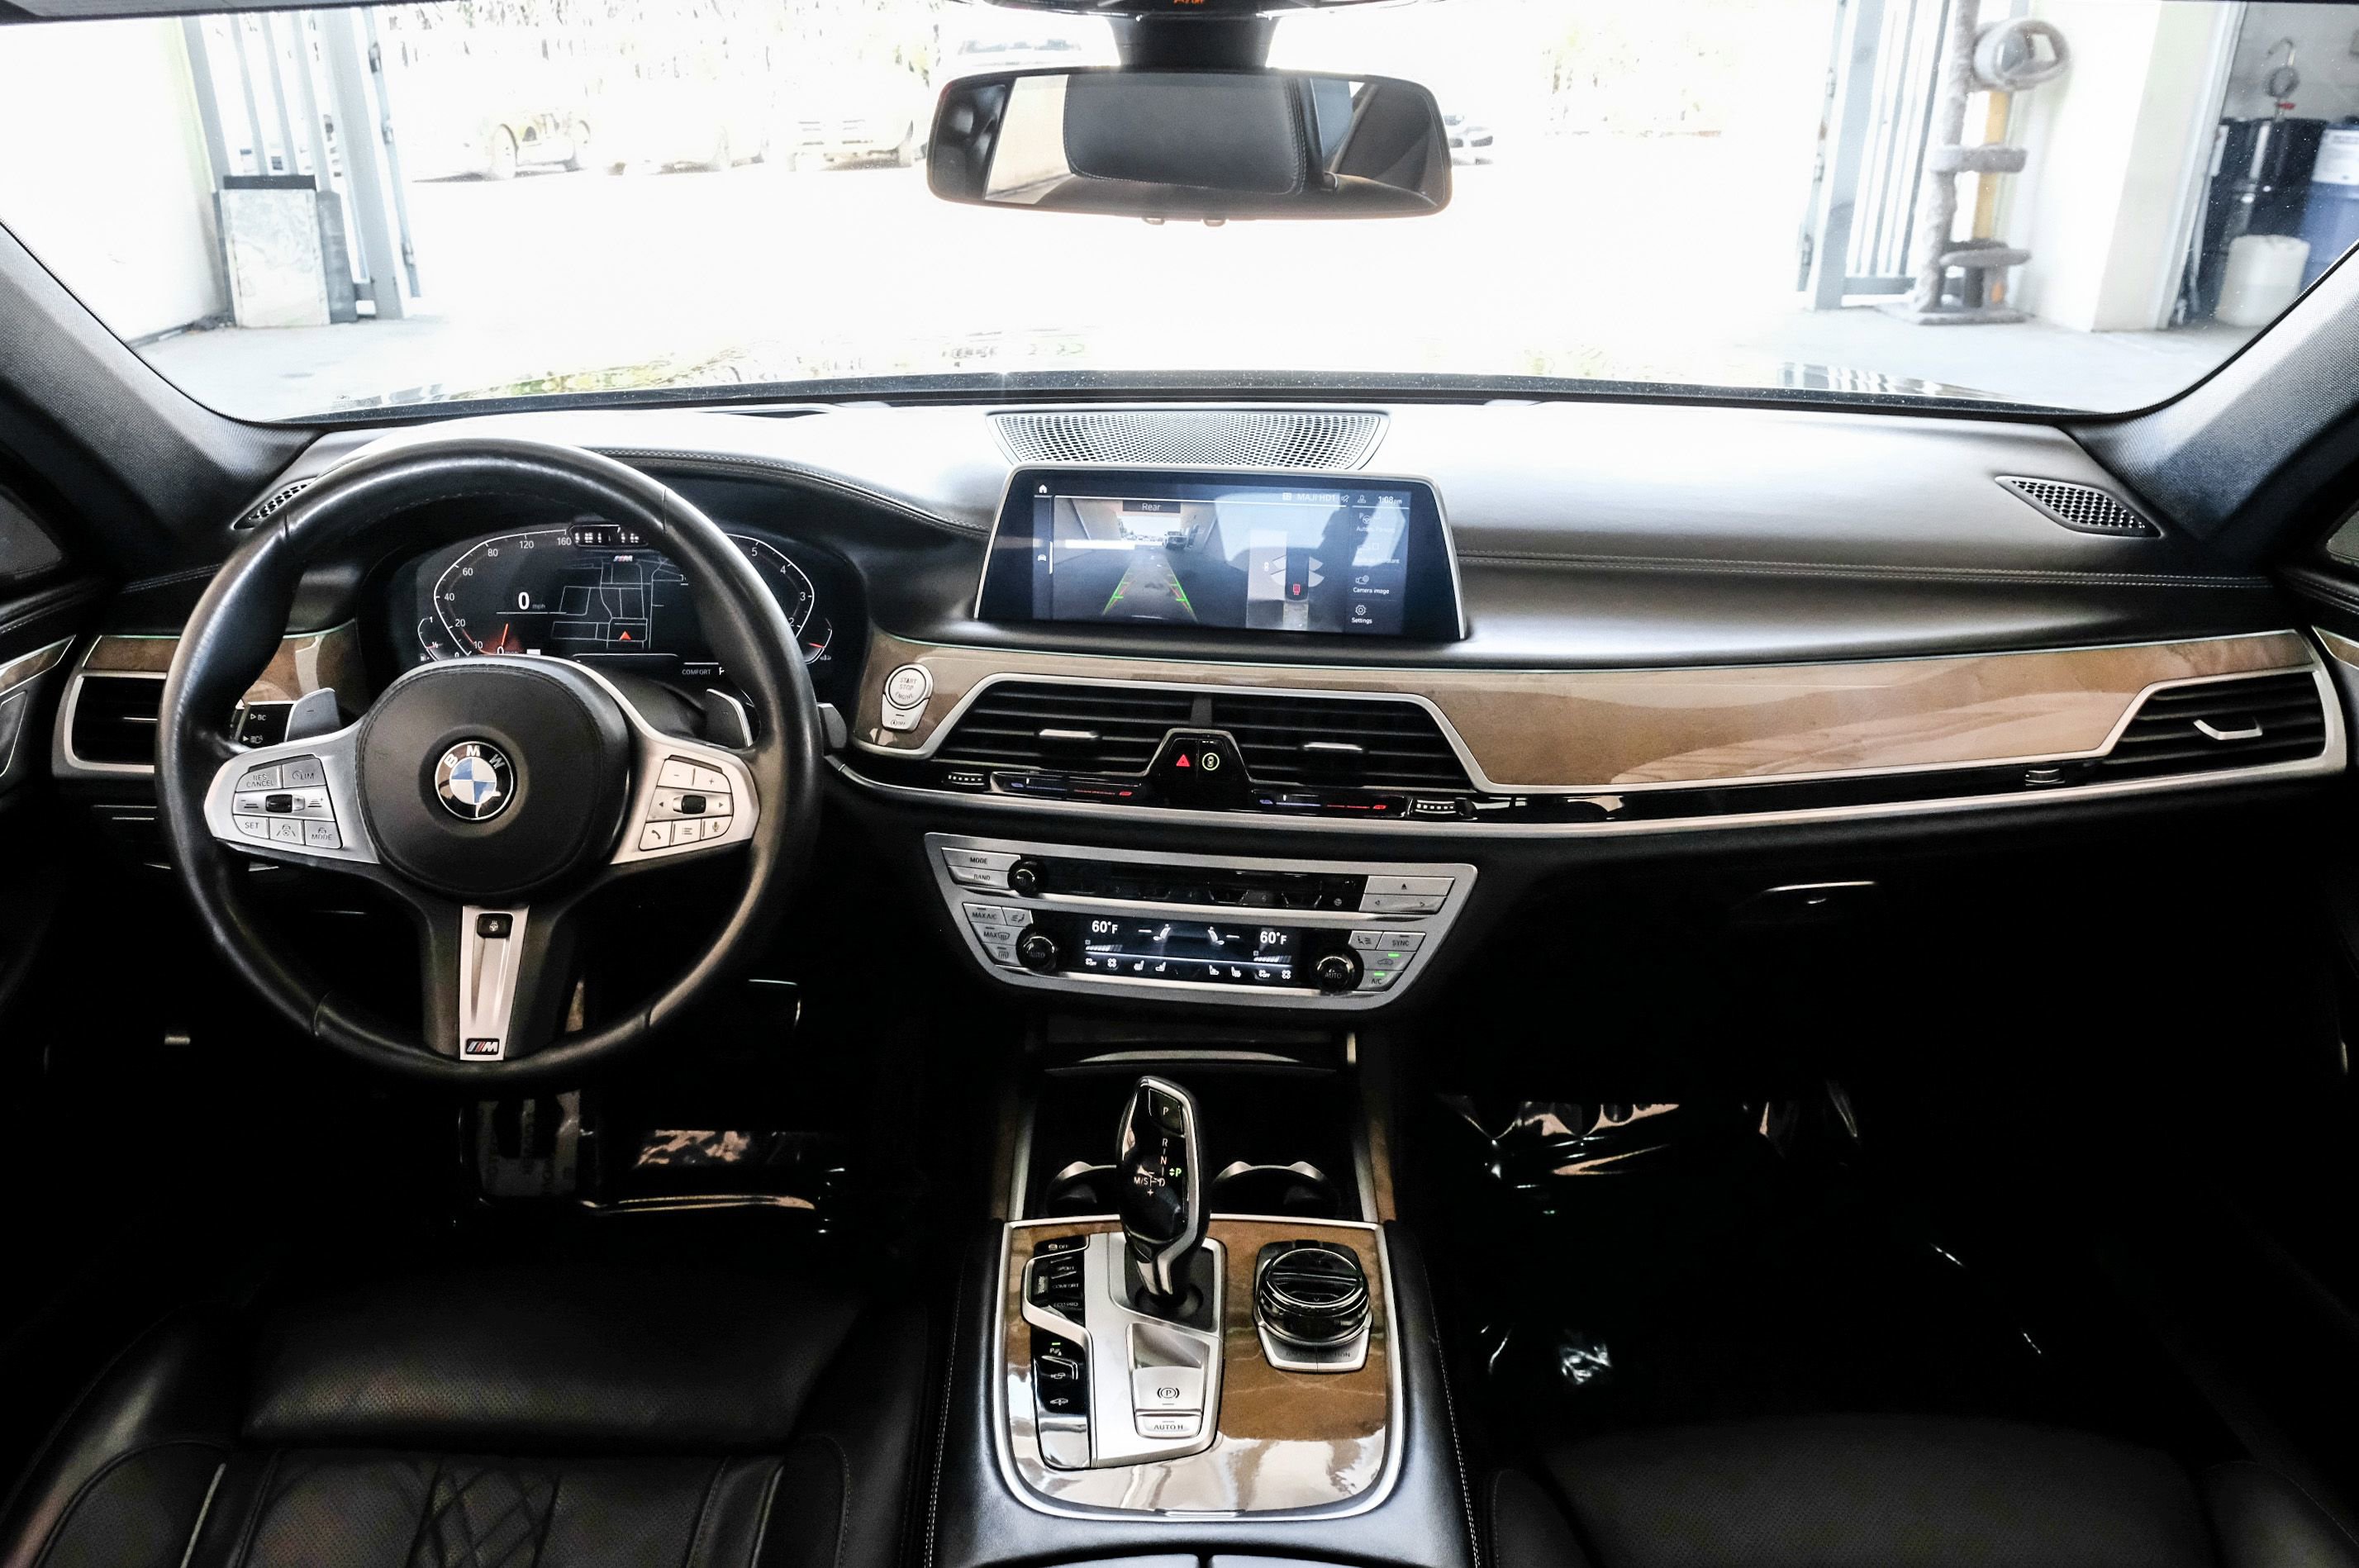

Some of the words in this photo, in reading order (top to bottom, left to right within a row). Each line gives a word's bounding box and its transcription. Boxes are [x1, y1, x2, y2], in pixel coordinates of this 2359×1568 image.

[1142, 502, 1162, 511] Rear
[519, 540, 535, 549] 120
[557, 537, 572, 546] 160
[487, 549, 498, 557] 80
[751, 547, 758, 557] 5
[462, 568, 473, 577] 60
[779, 565, 787, 574] 4
[444, 593, 455, 601] 40
[518, 592, 530, 610] 0
[799, 592, 806, 601] 3
[454, 619, 466, 627] 20
[788, 617, 795, 627] 2
[473, 640, 483, 649] 10
[444, 745, 506, 769] BMW
[246, 780, 274, 788] CANCEL
[1092, 919, 1119, 934] 60°F
[983, 930, 997, 938] MAX
[1259, 930, 1287, 945] 60°F
[1163, 1106, 1169, 1116] P
[1162, 1138, 1168, 1147] R
[1160, 1156, 1168, 1166] N
[1175, 1167, 1182, 1177] P
[1134, 1176, 1149, 1186] M/S
[1158, 1178, 1166, 1187] D
